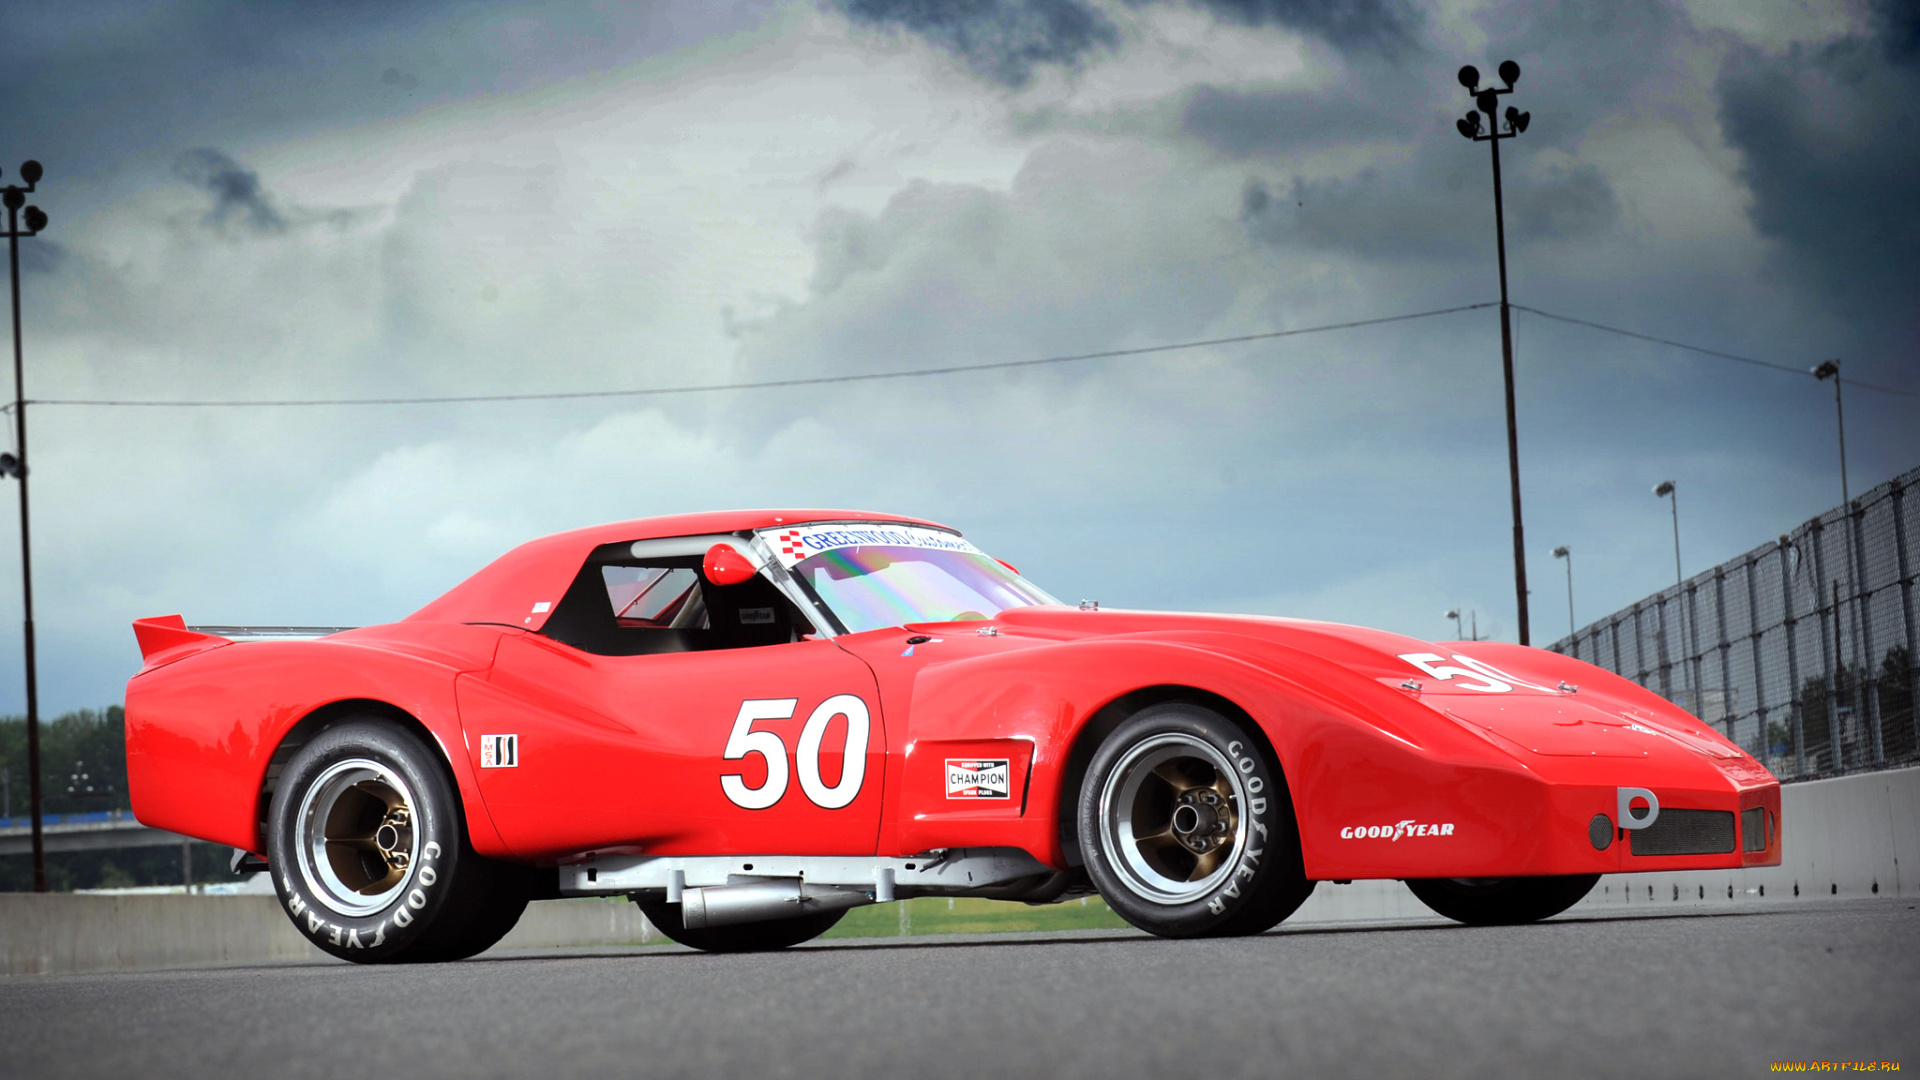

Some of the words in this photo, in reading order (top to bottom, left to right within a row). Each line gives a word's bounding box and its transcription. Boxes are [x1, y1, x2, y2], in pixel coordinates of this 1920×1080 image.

[802, 530, 911, 550] GREENWOOD
[1396, 652, 1559, 693] 50
[484, 736, 493, 766] IMSA
[719, 693, 871, 811] 50
[951, 774, 1004, 785] CHAMPION
[1208, 741, 1267, 916] GOODYEAR
[1340, 819, 1455, 842] GOODYEAR
[288, 841, 441, 949] GOODYEAR
